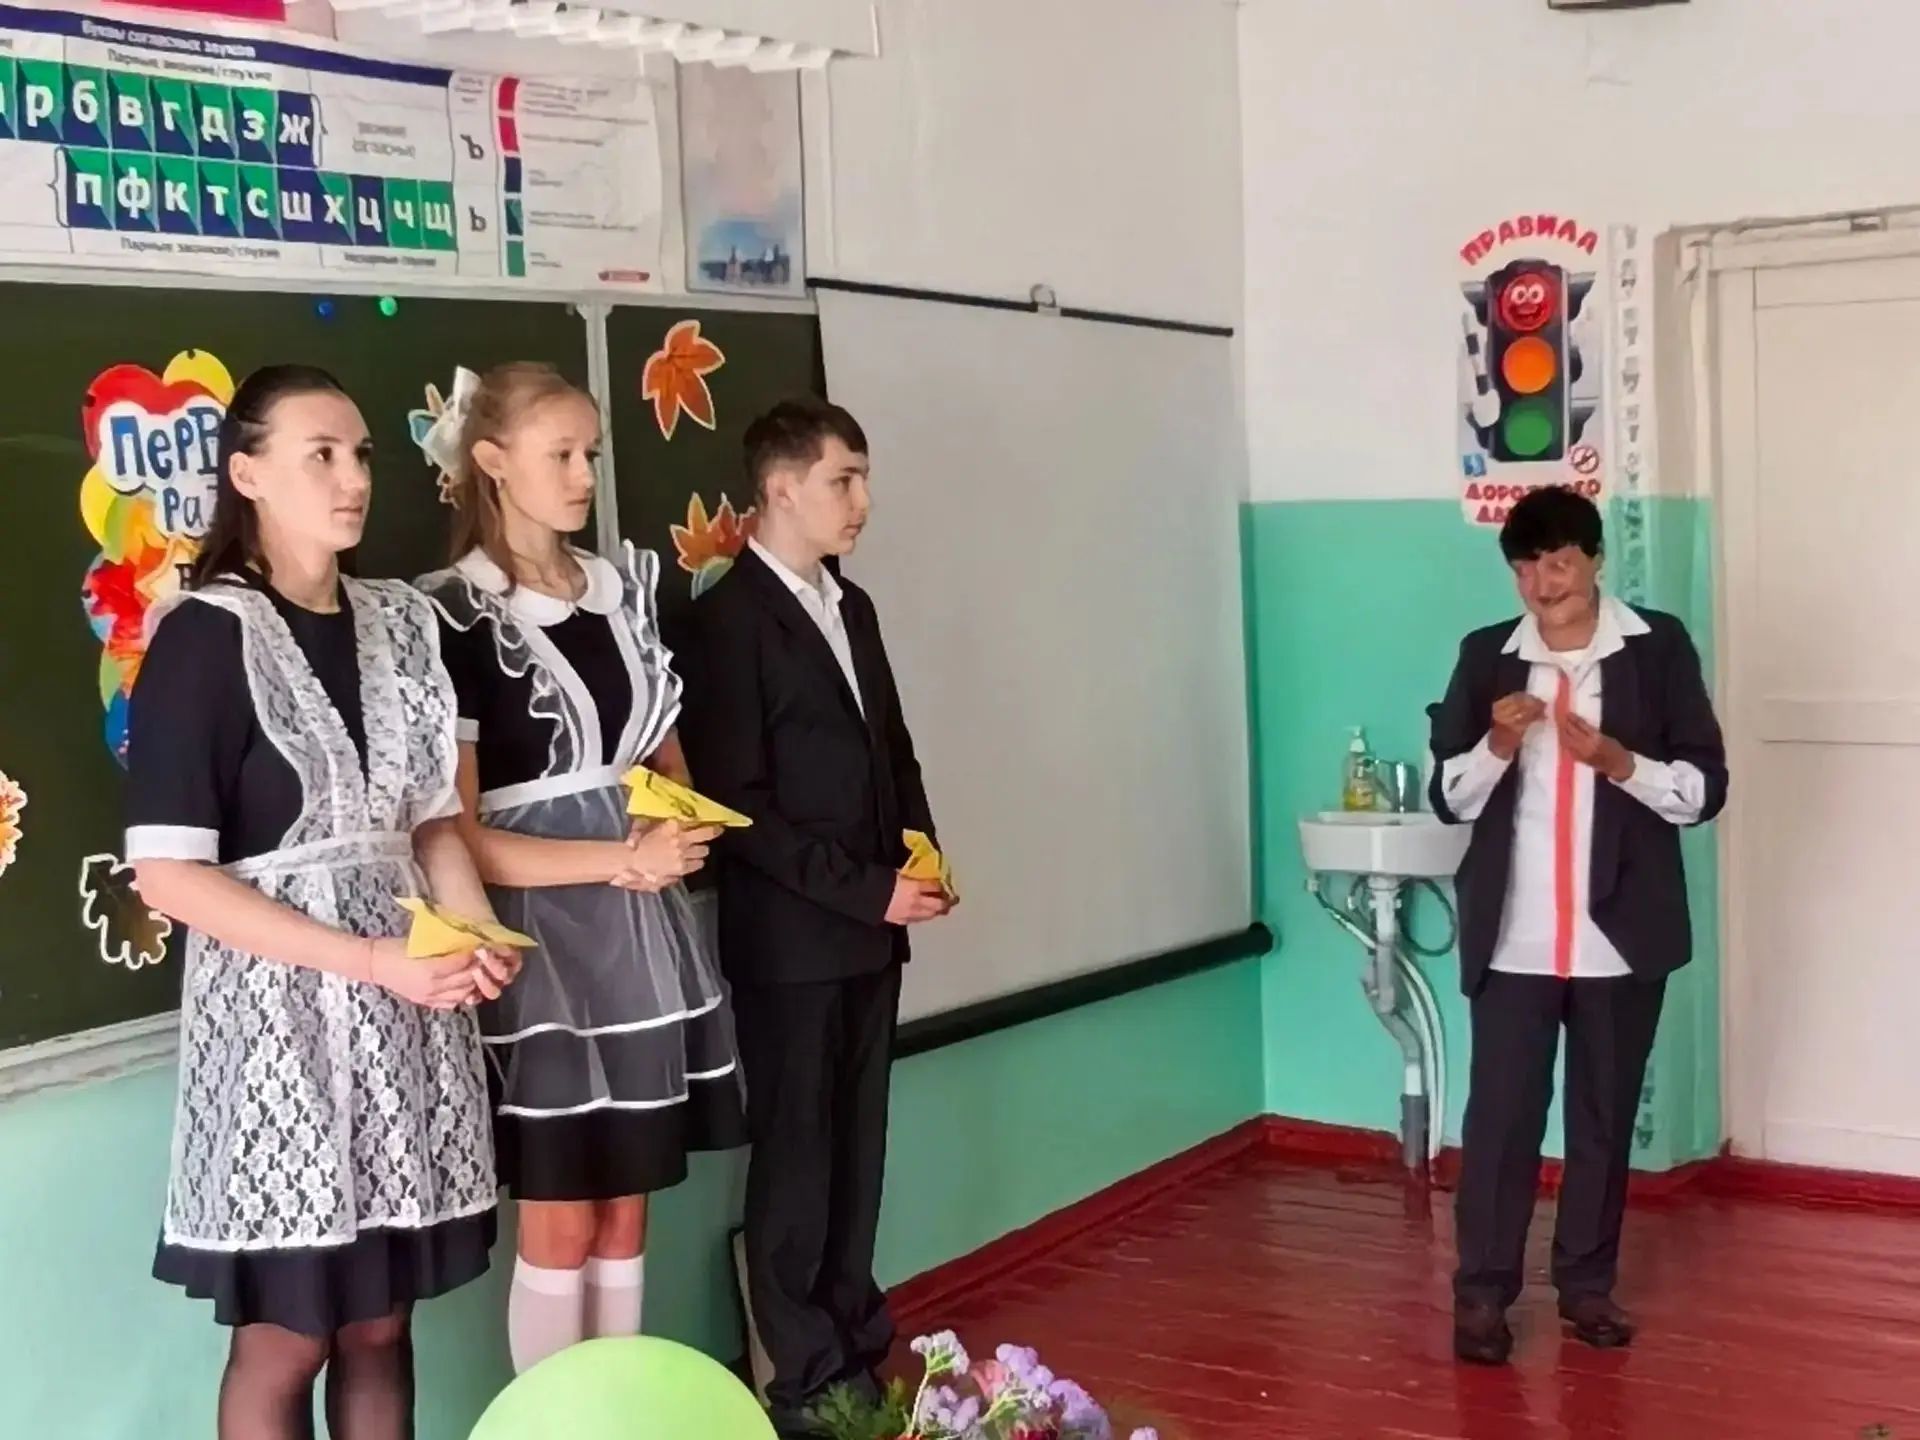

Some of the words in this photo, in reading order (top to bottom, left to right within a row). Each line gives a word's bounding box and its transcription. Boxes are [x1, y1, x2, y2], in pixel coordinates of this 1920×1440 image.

[26, 85, 53, 127] р
[73, 80, 98, 124] б
[119, 94, 144, 127] в
[161, 100, 181, 131] г
[201, 106, 230, 143] д
[242, 110, 265, 140] з
[279, 112, 311, 146] ж
[76, 172, 103, 207] п
[117, 167, 150, 219] ф
[165, 180, 190, 213] к
[206, 185, 229, 216] т
[247, 188, 268, 219] с
[281, 191, 312, 222] ш
[323, 194, 346, 224] х
[358, 196, 382, 233] ц
[393, 199, 415, 228] ч
[424, 201, 454, 238] щ
[1459, 215, 1599, 266] ПРАВИЛА
[1465, 478, 1601, 500] ДОРООГО
